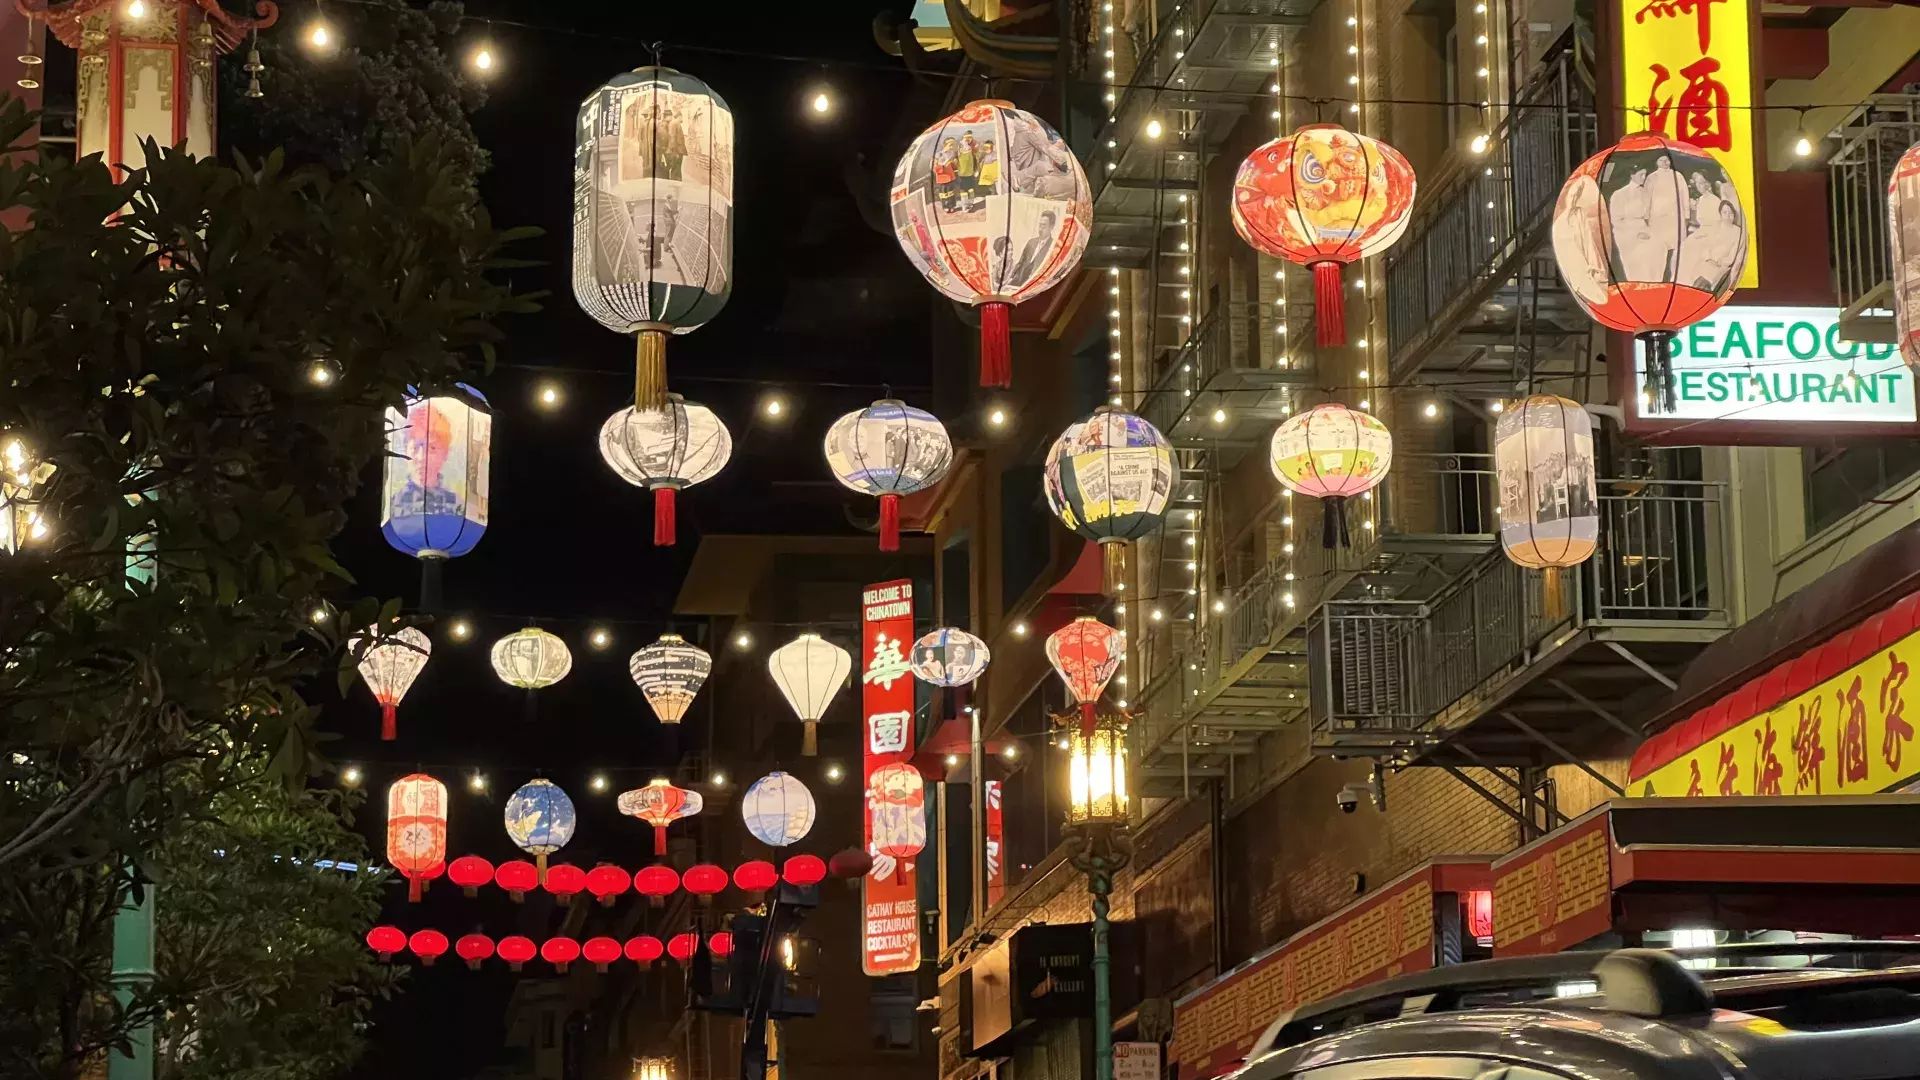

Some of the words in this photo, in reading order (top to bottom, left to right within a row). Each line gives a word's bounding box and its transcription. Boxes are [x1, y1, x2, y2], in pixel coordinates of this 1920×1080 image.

[863, 586, 900, 605] WELCOME
[901, 584, 912, 599] TO
[866, 601, 911, 621] CHINATOWN
[866, 902, 894, 918] CATHAY
[894, 899, 917, 915] HOUSE
[866, 916, 917, 934] RESTAURANT
[866, 933, 908, 952] COCKTAILS
